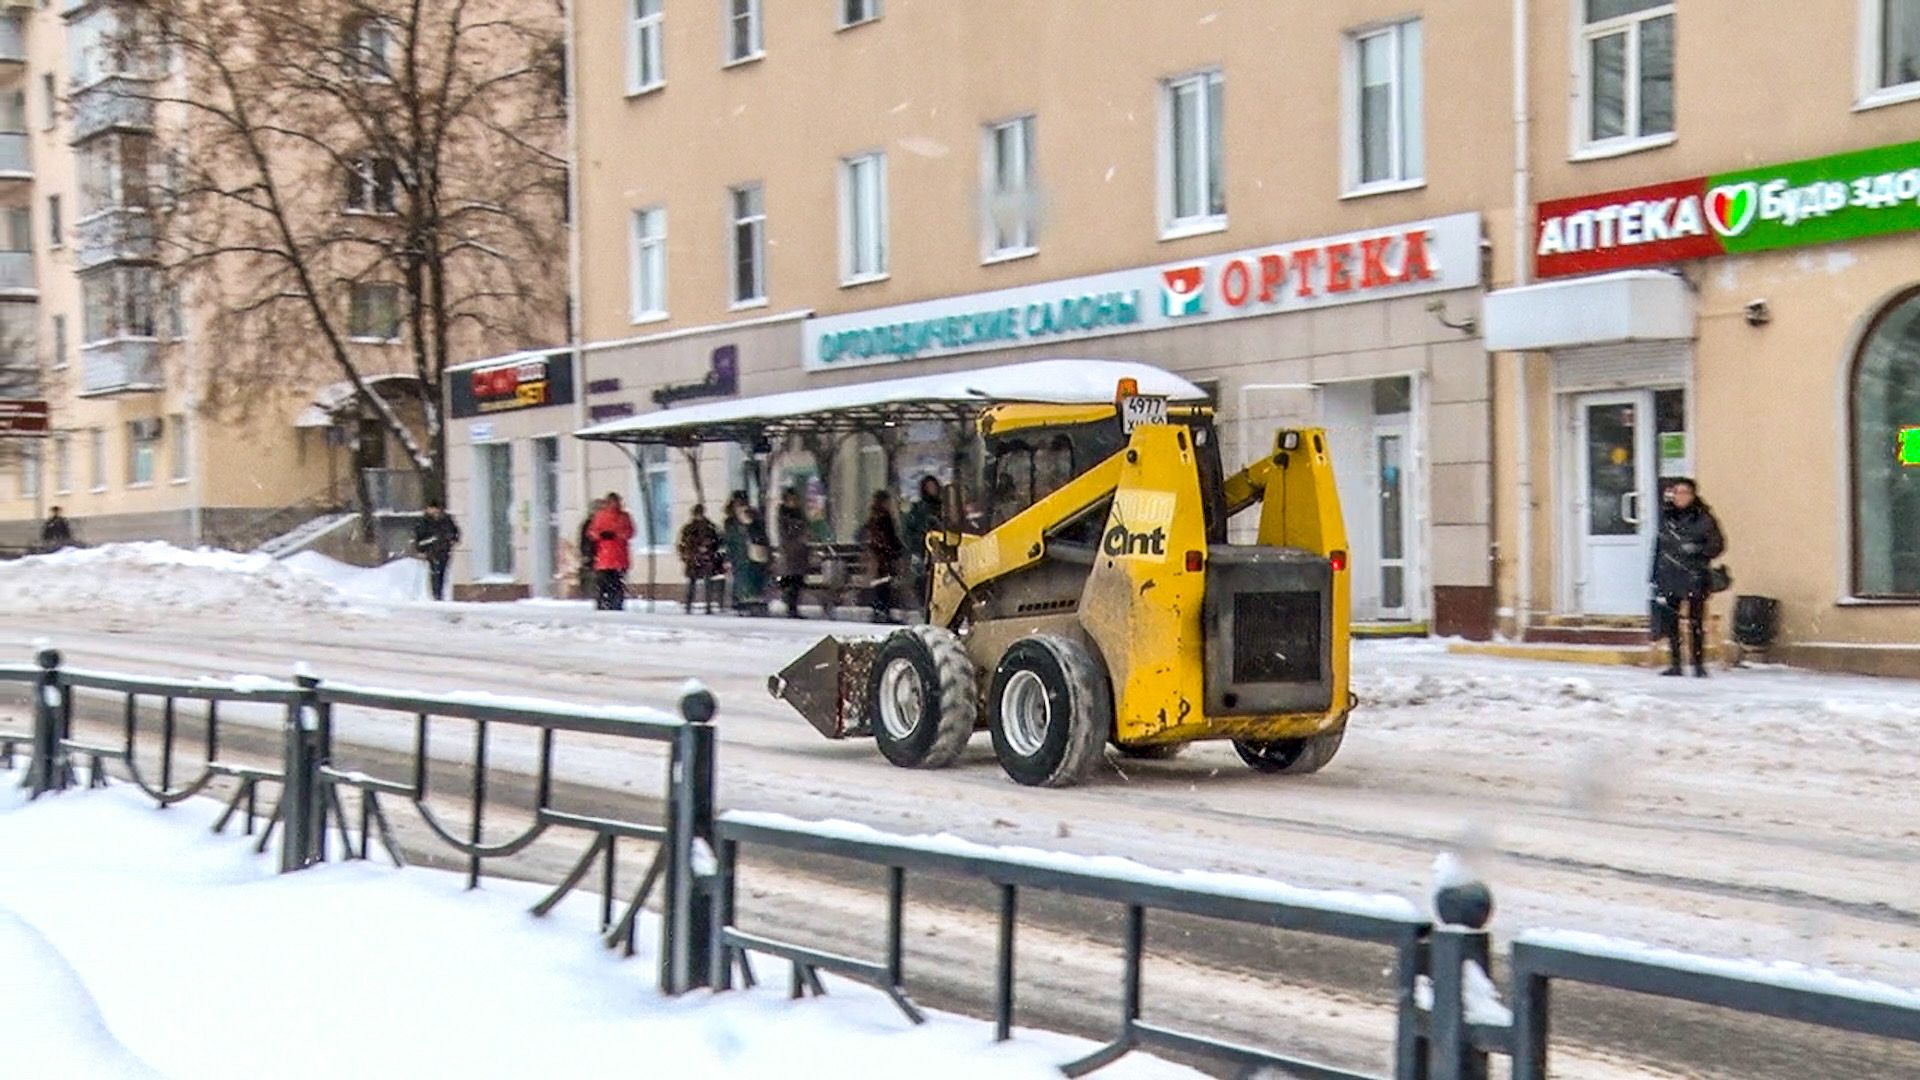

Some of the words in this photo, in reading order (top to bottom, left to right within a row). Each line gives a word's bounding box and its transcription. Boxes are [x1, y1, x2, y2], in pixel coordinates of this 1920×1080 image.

[1849, 167, 1920, 209] здо
[1538, 194, 1705, 256] АПТЕКА
[1221, 230, 1434, 307] ОРТЕКА
[820, 307, 1018, 362] ОРТОПЕДИЧЕСКИЕ
[1026, 290, 1140, 338] САЛОНЫ
[1129, 398, 1161, 414] 4977
